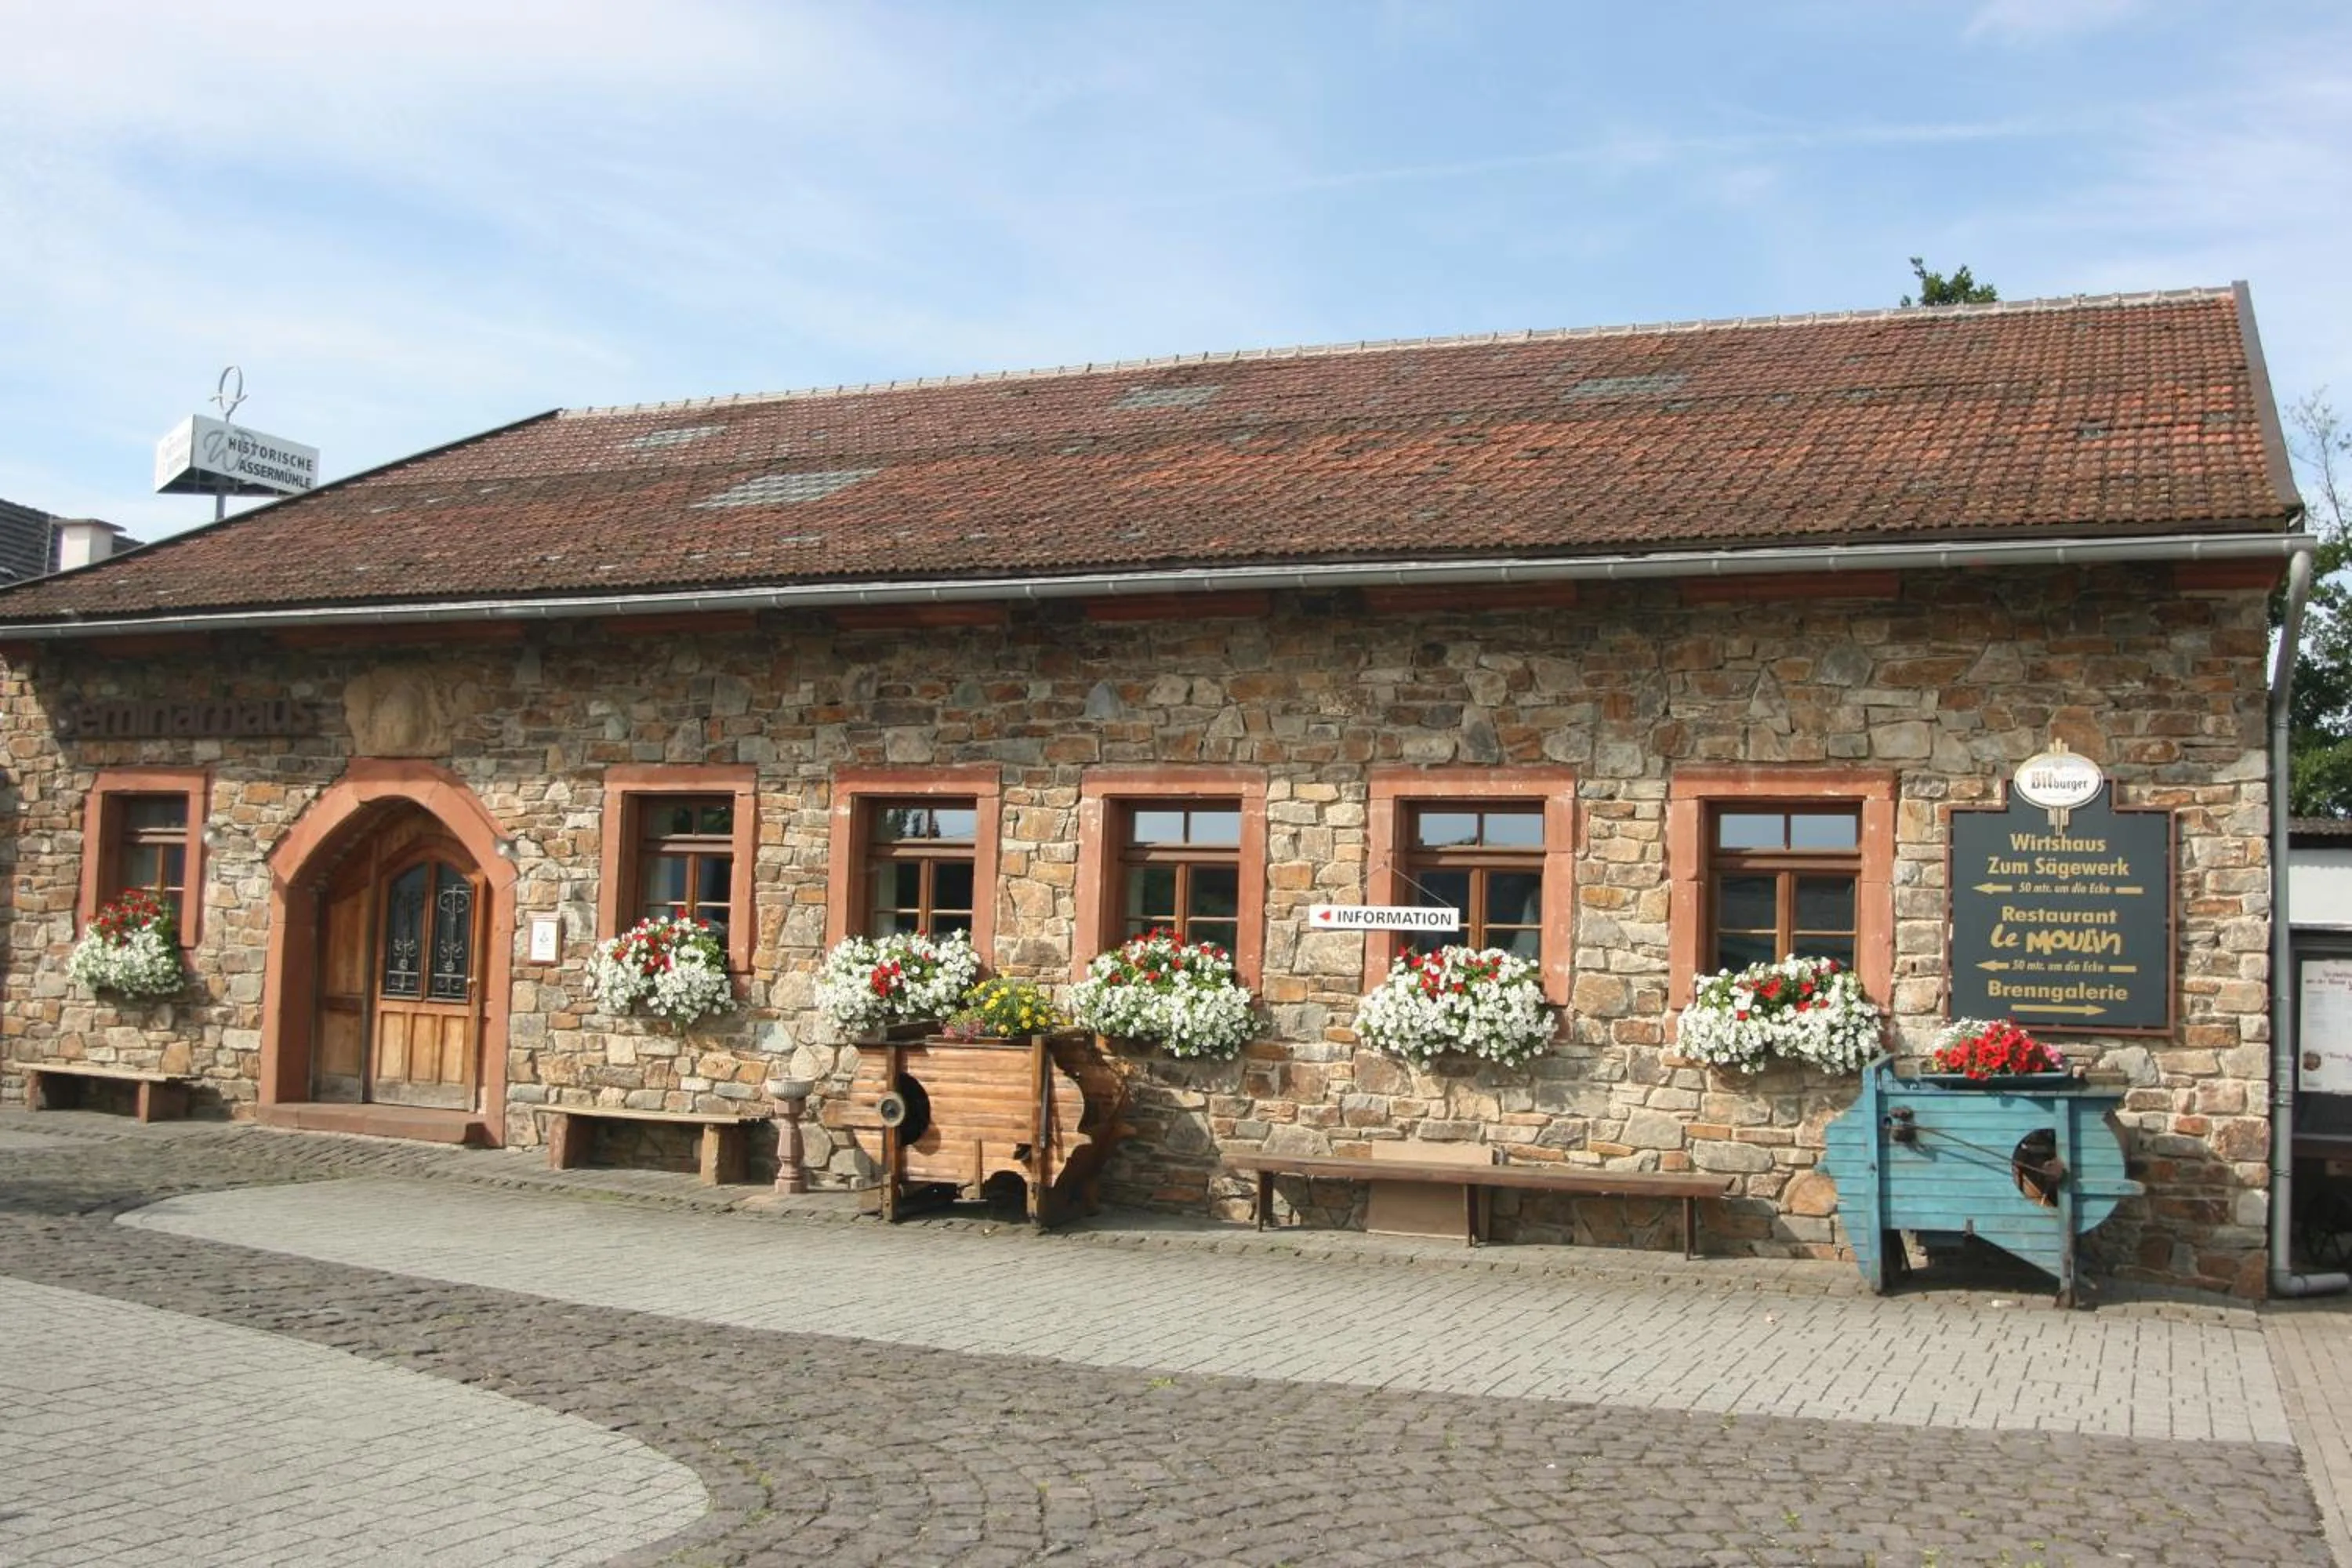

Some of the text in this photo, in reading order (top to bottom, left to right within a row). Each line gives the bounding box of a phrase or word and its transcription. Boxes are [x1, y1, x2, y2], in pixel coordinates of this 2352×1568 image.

[228, 437, 313, 471] HISTORISCHE
[2031, 770, 2089, 791] Bitburger
[2009, 833, 2107, 851] Wirtshaus
[1987, 858, 2129, 879] Zum Sägewerk
[2019, 882, 2031, 893] 50
[2054, 884, 2070, 894] um
[2071, 882, 2087, 894] die
[2089, 883, 2111, 894] Ecke
[1338, 910, 1451, 925] INFORMATION
[2002, 906, 2118, 924] Restaurant
[2012, 959, 2025, 971] 50
[2064, 960, 2080, 971] die
[2082, 960, 2103, 972] Ecke
[1987, 980, 2129, 1002] Brenngalerie
